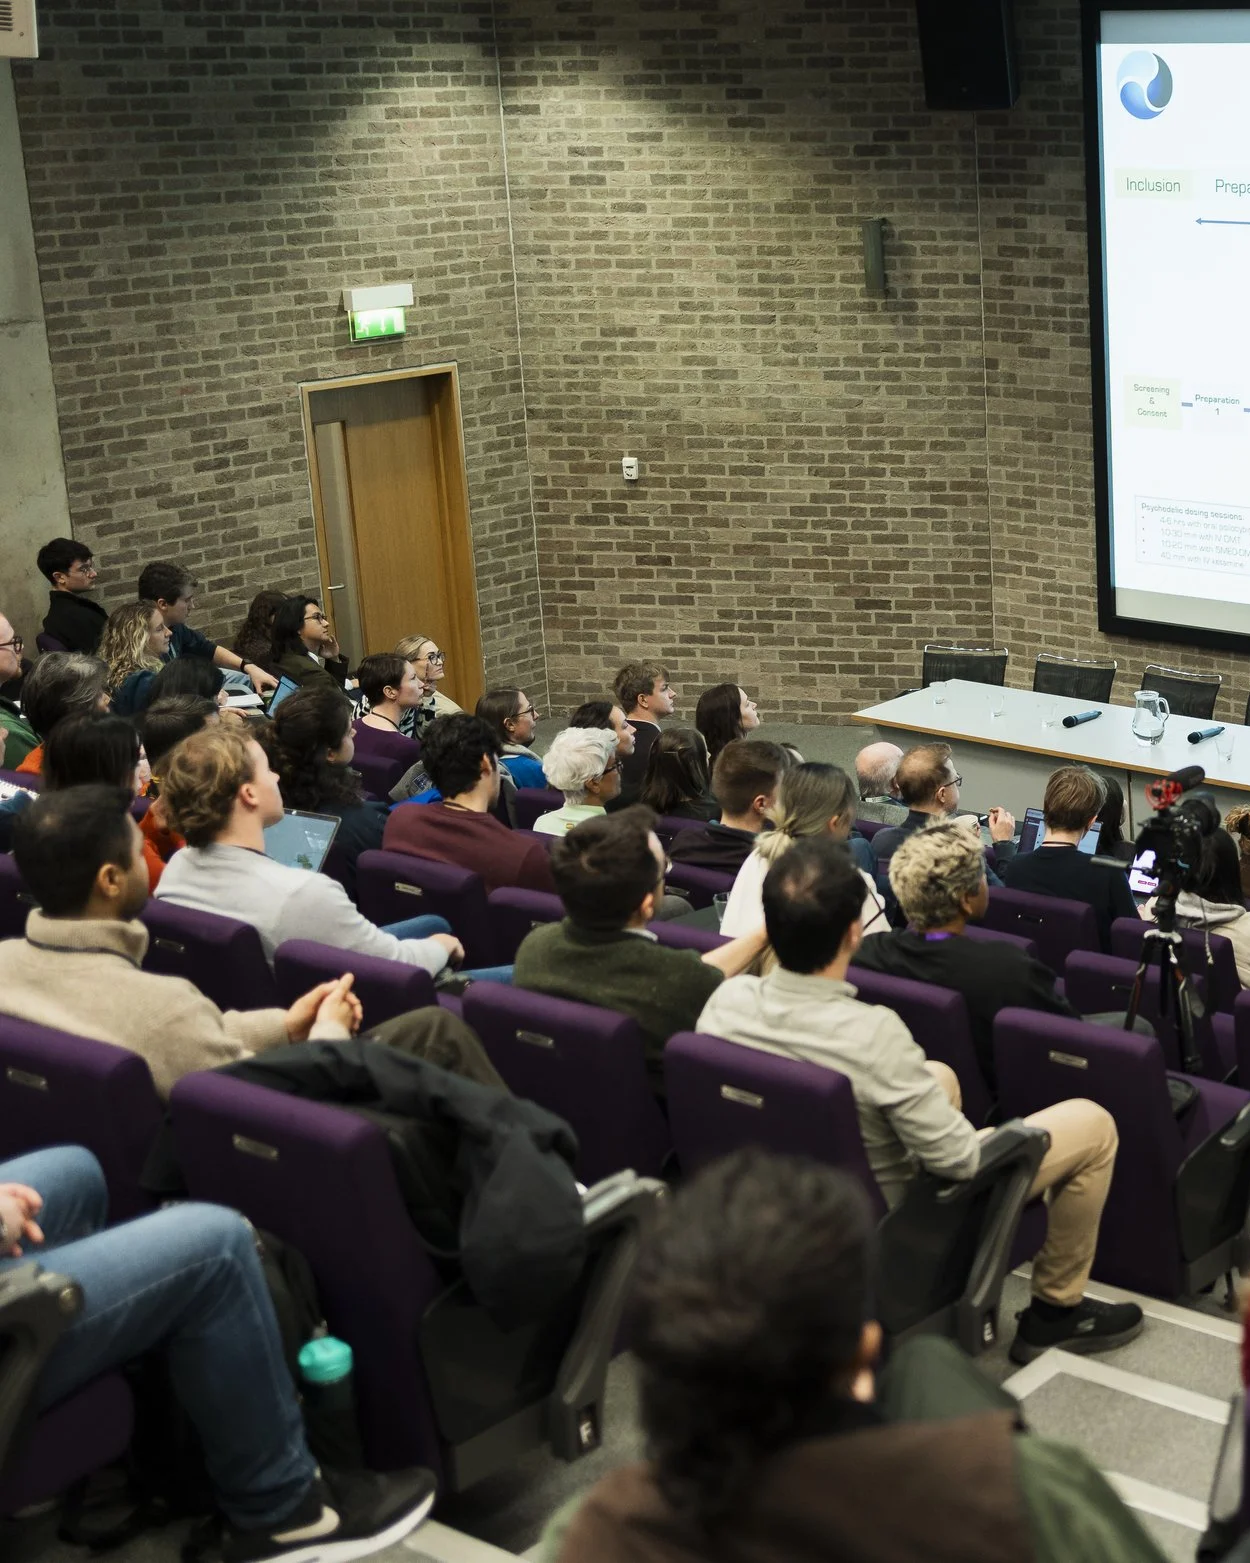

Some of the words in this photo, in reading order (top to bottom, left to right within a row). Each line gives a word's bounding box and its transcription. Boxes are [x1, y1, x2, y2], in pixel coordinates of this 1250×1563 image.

[1126, 177, 1181, 193] Inclusion
[1134, 384, 1170, 395] Screening
[1195, 394, 1240, 405] Preparation
[1138, 408, 1167, 418] Consent
[580, 1421, 592, 1444] F
